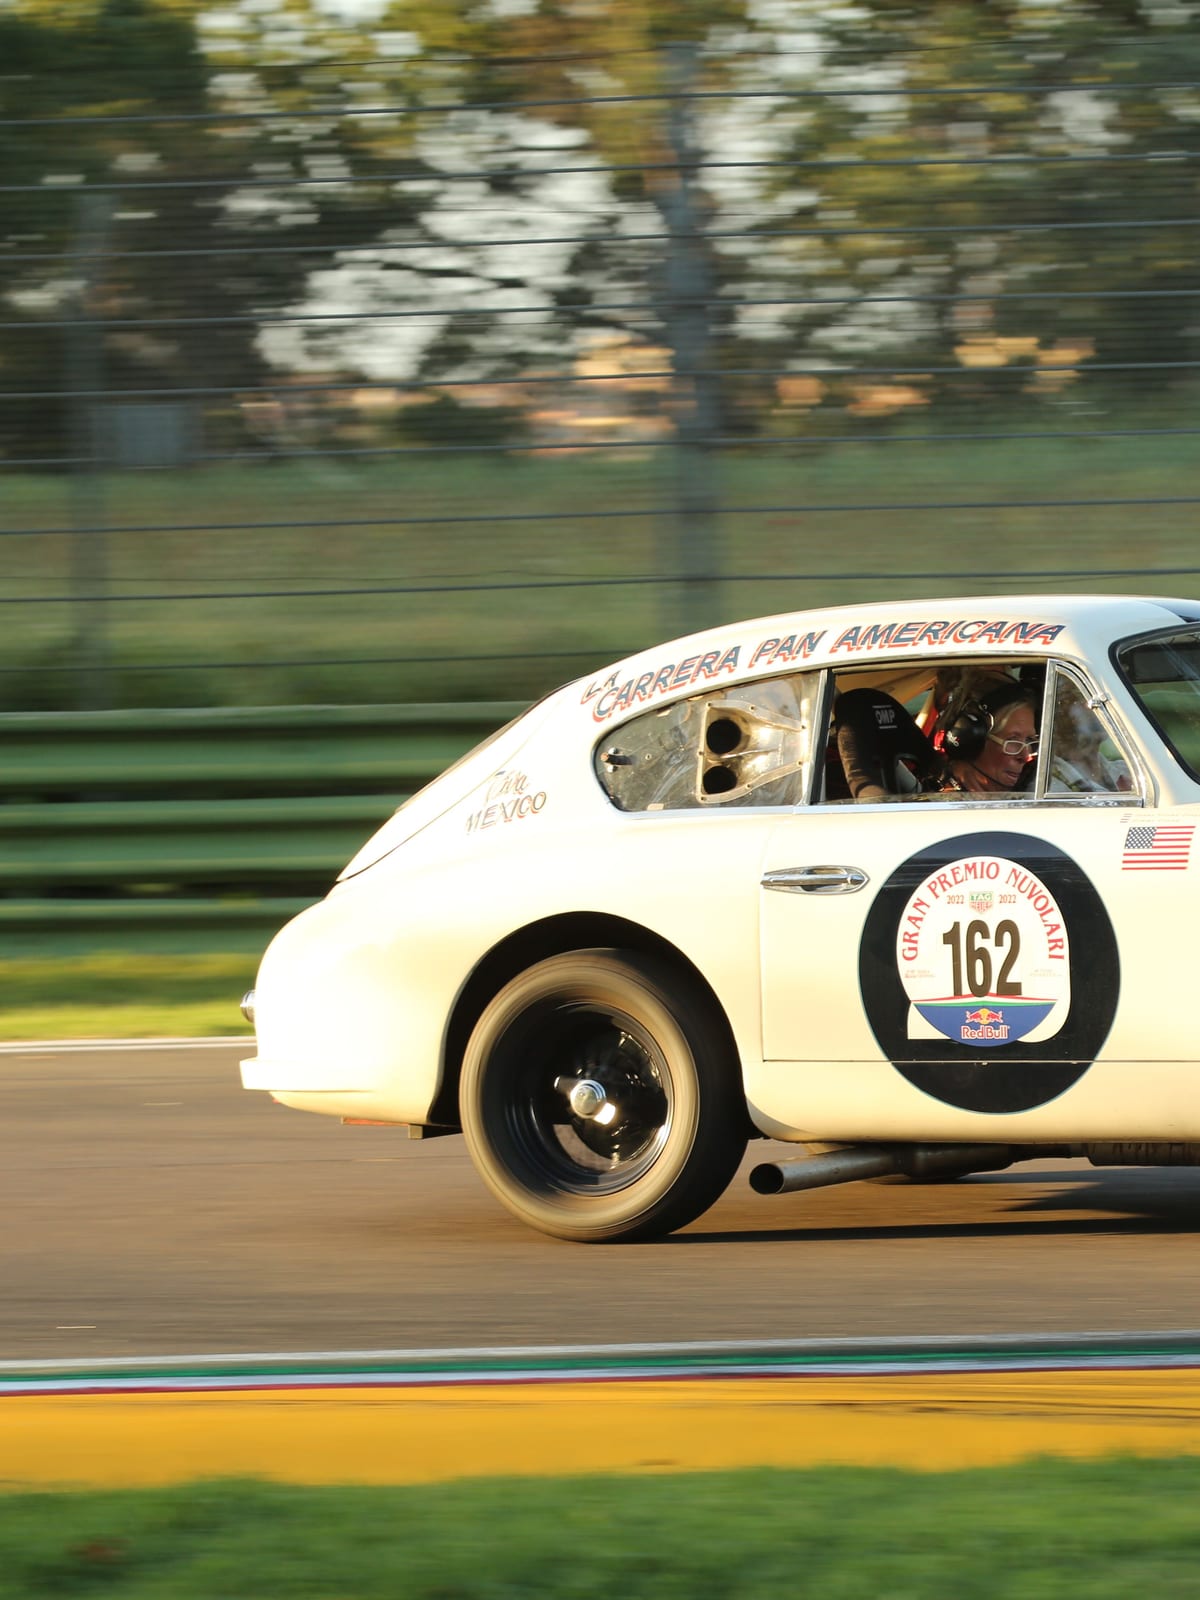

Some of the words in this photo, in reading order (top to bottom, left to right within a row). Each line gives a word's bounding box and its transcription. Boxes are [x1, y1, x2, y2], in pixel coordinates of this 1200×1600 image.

[580, 668, 622, 705] LA
[592, 644, 741, 723] CARRERA
[748, 630, 828, 668] PAN
[829, 620, 1066, 653] AMERICANA
[902, 897, 930, 961] GRAN
[927, 861, 1000, 899] PREMIO
[1005, 868, 1065, 960] NUVOLARI
[947, 895, 965, 904] 2022
[999, 894, 1017, 904] 2022
[942, 919, 1022, 998] 162
[961, 1025, 984, 1039] Red
[984, 1025, 1008, 1039] Bull
